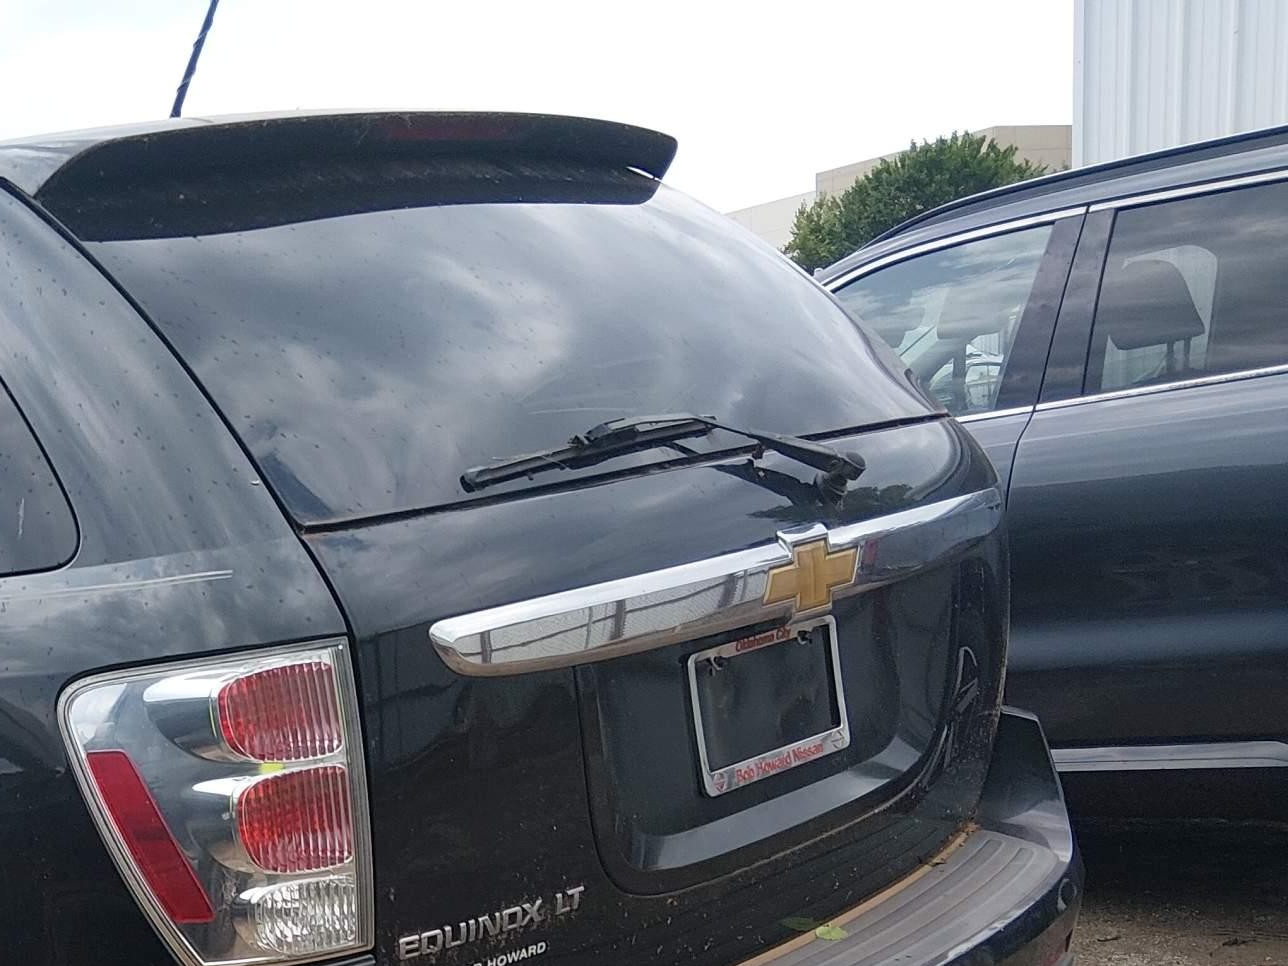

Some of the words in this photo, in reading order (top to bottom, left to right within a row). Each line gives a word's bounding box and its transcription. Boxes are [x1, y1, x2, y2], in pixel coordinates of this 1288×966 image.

[735, 766, 754, 784] Bob
[756, 755, 791, 776] Howard
[792, 742, 824, 763] Nissan
[399, 896, 543, 960] EQUINOX
[555, 886, 585, 915] LT
